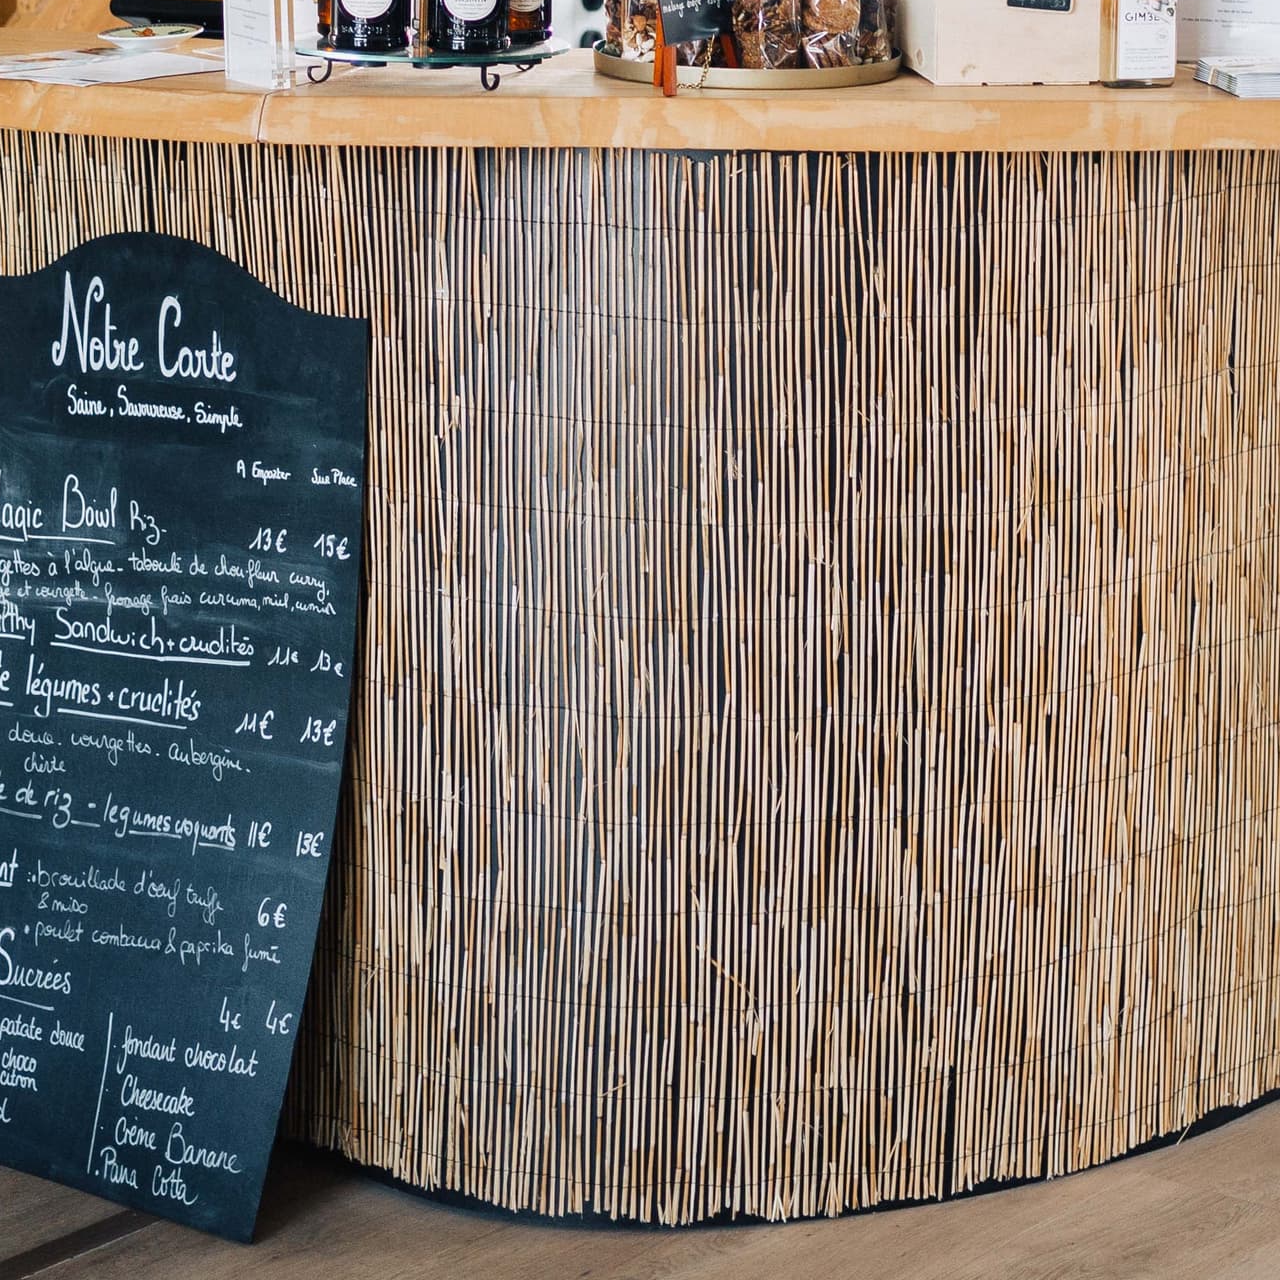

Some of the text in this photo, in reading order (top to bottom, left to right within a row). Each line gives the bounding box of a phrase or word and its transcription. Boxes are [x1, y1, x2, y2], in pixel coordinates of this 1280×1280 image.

[52, 270, 237, 382] Notre Carte
[194, 402, 243, 433] Simple
[236, 459, 246, 478] A
[331, 468, 358, 487] Place
[62, 474, 117, 532] Bowl
[47, 551, 58, 576] à
[128, 547, 183, 573] taboulé
[189, 553, 208, 575] de
[249, 527, 351, 560] 13€ 15€
[17, 579, 31, 598] et
[35, 579, 89, 605] courgette
[104, 582, 153, 616] fromage
[161, 585, 192, 615] frais
[54, 607, 164, 654] Sandwich
[179, 624, 255, 656] crudités
[25, 653, 102, 718] légumes
[118, 677, 201, 721] crudités
[15, 779, 38, 806] de
[44, 788, 72, 829] riz
[296, 830, 324, 857] 13€
[257, 896, 288, 928] 6€
[34, 921, 84, 947] poulet
[180, 929, 235, 966] paprika
[220, 996, 293, 1035] 4€ 4€
[50, 1020, 85, 1052] douce
[116, 1024, 259, 1078] fondant chocolat
[1, 1047, 37, 1073] choco
[0, 1069, 38, 1092] citron
[120, 1073, 195, 1117] Cheesecake
[164, 1121, 242, 1174] Banane
[152, 1164, 200, 1206] Cotta
